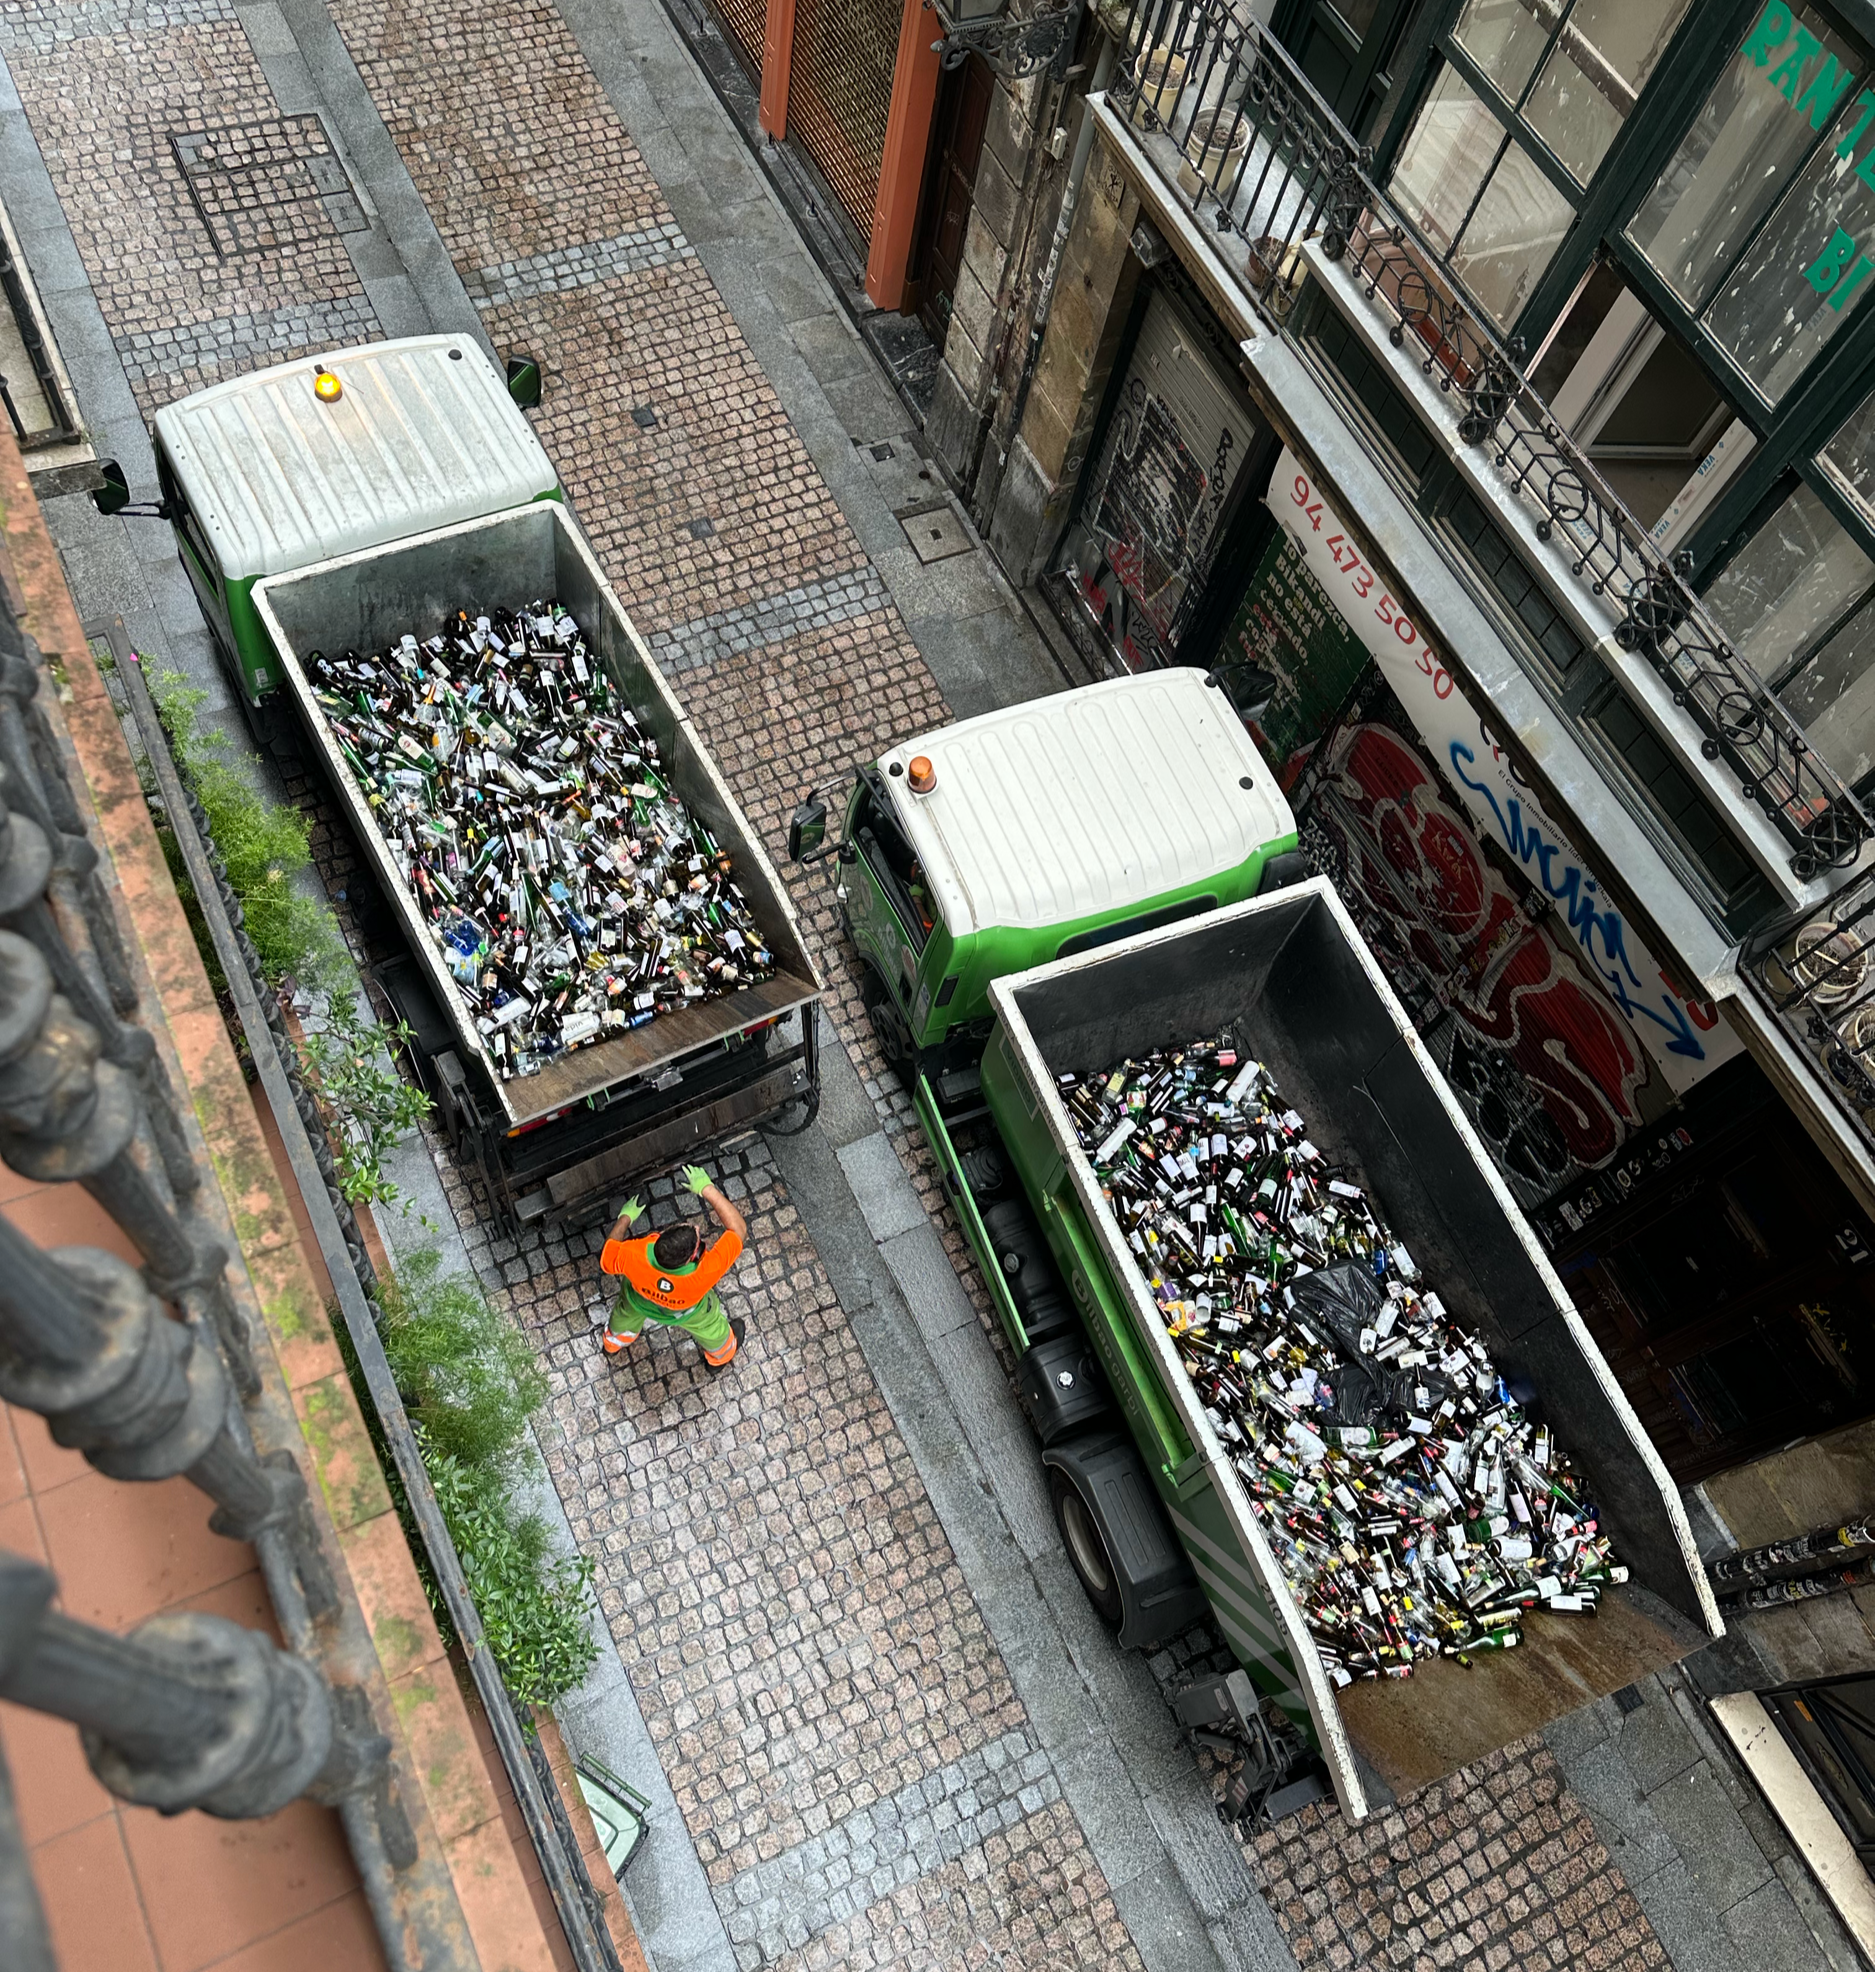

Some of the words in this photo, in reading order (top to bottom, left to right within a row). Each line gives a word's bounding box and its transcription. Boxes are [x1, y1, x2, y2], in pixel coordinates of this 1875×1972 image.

[1267, 571, 1285, 598] no
[1284, 593, 1312, 639] está
[1275, 553, 1327, 631] Bikandi
[1290, 475, 1324, 532] 94
[1326, 534, 1374, 598] 473
[1374, 594, 1417, 645] 50
[1415, 647, 1454, 700] 50
[1295, 559, 1350, 643] parezca,
[1497, 769, 1507, 778] El
[1505, 776, 1527, 804] Grupo
[1525, 802, 1568, 849] Inmobiliario
[1006, 1049, 1031, 1103] VIDRIO
[1836, 1228, 1869, 1264] 21
[1111, 1361, 1139, 1416] garbi
[1258, 1583, 1291, 1637] 2105
